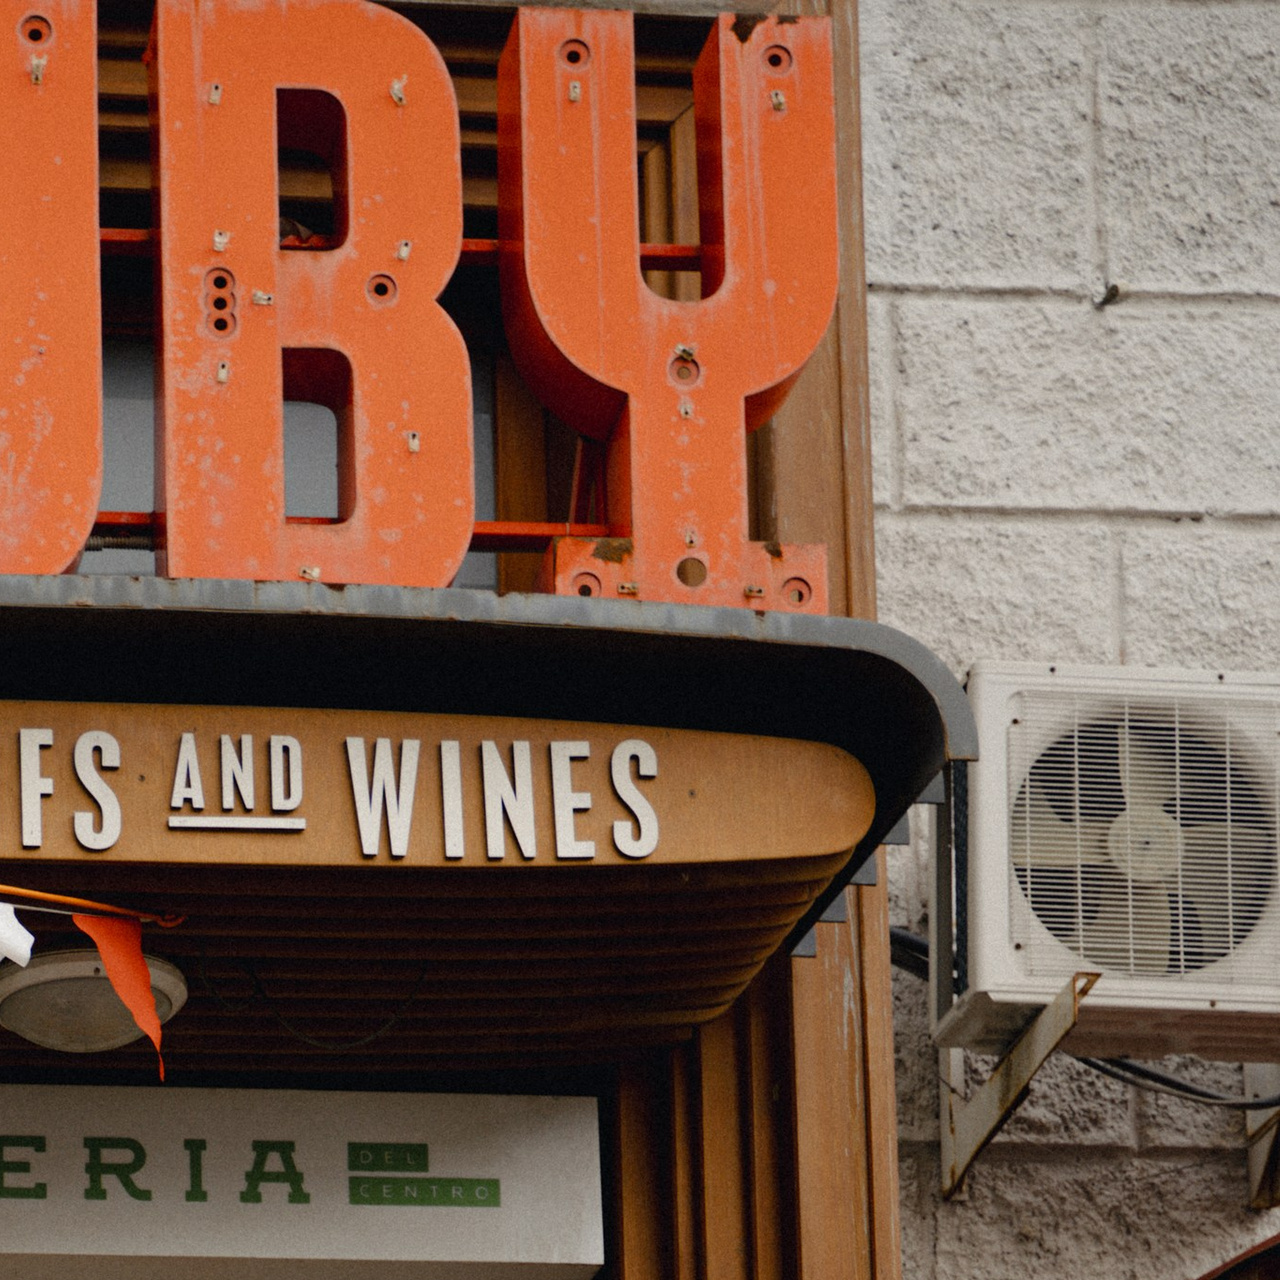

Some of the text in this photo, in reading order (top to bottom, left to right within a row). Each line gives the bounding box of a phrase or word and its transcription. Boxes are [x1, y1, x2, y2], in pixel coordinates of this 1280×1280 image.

[170, 732, 303, 812] AND
[346, 736, 659, 858] WINES
[359, 1151, 415, 1165] DEL
[359, 1184, 489, 1200] CENTRO
